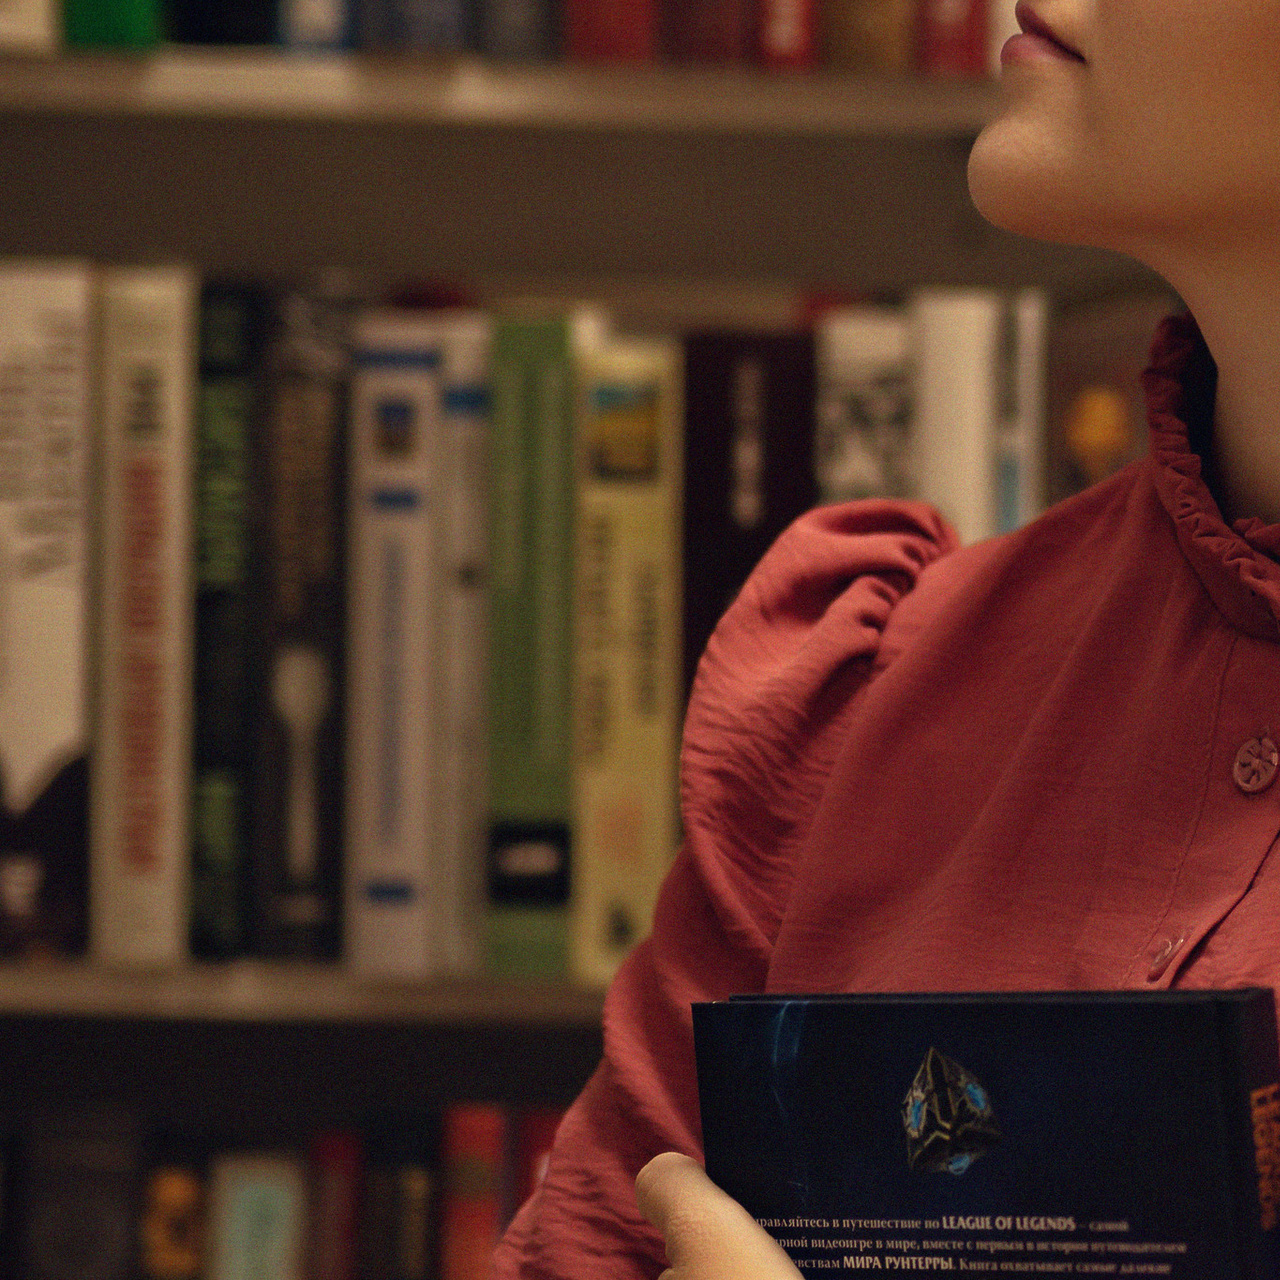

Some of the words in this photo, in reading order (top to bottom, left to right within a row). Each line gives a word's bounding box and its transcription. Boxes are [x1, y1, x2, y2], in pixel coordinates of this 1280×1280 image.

[832, 1219, 840, 1228] в
[842, 1219, 921, 1231] путешествие
[924, 1219, 940, 1229] по
[942, 1216, 993, 1230] LEAGUE
[995, 1216, 1013, 1230] OF
[1015, 1216, 1077, 1231] LEGENDS
[811, 1239, 873, 1252] видеоигре
[886, 1239, 920, 1252] мире,
[922, 1241, 964, 1250] вместе
[794, 1258, 840, 1269] вствам
[843, 1256, 882, 1269] МИРА
[885, 1256, 955, 1270] РУНТЕРРЫ.
